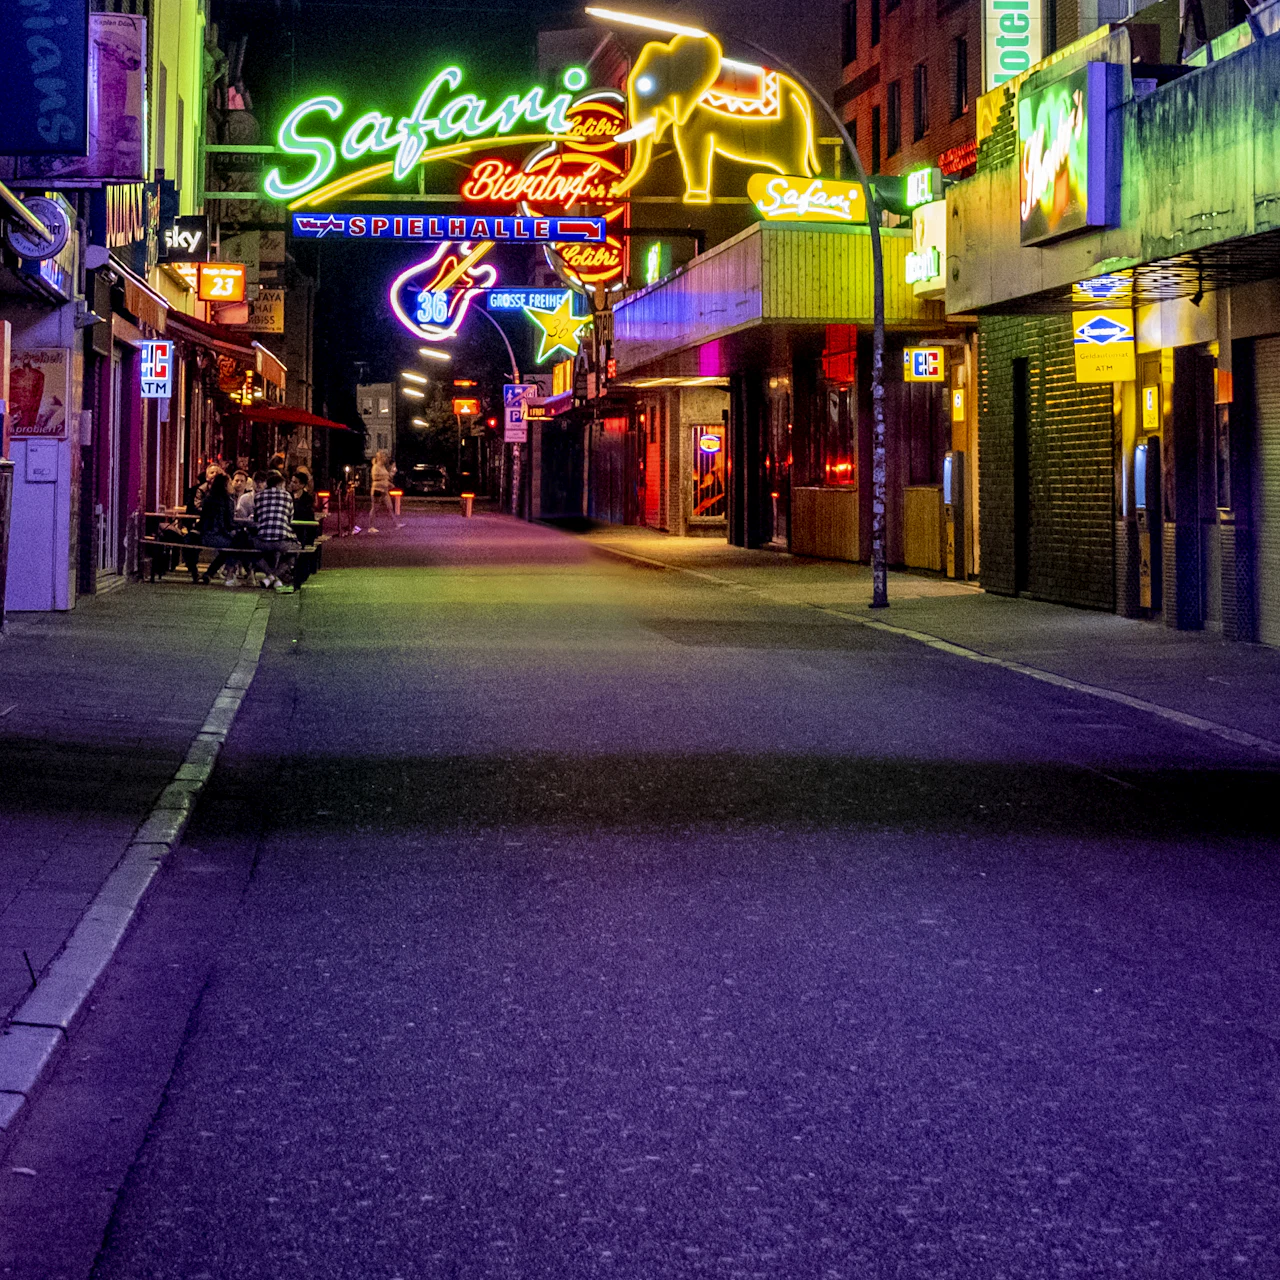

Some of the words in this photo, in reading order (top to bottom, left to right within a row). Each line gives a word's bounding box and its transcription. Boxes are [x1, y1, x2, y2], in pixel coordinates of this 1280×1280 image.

[264, 67, 587, 202] Safari
[757, 177, 859, 214] Safari
[165, 225, 202, 254] sky
[348, 216, 551, 238] SPIELHALLE
[210, 277, 234, 296] 23
[417, 291, 449, 324] 36
[490, 293, 526, 308] GROSSE
[547, 317, 569, 339] 36
